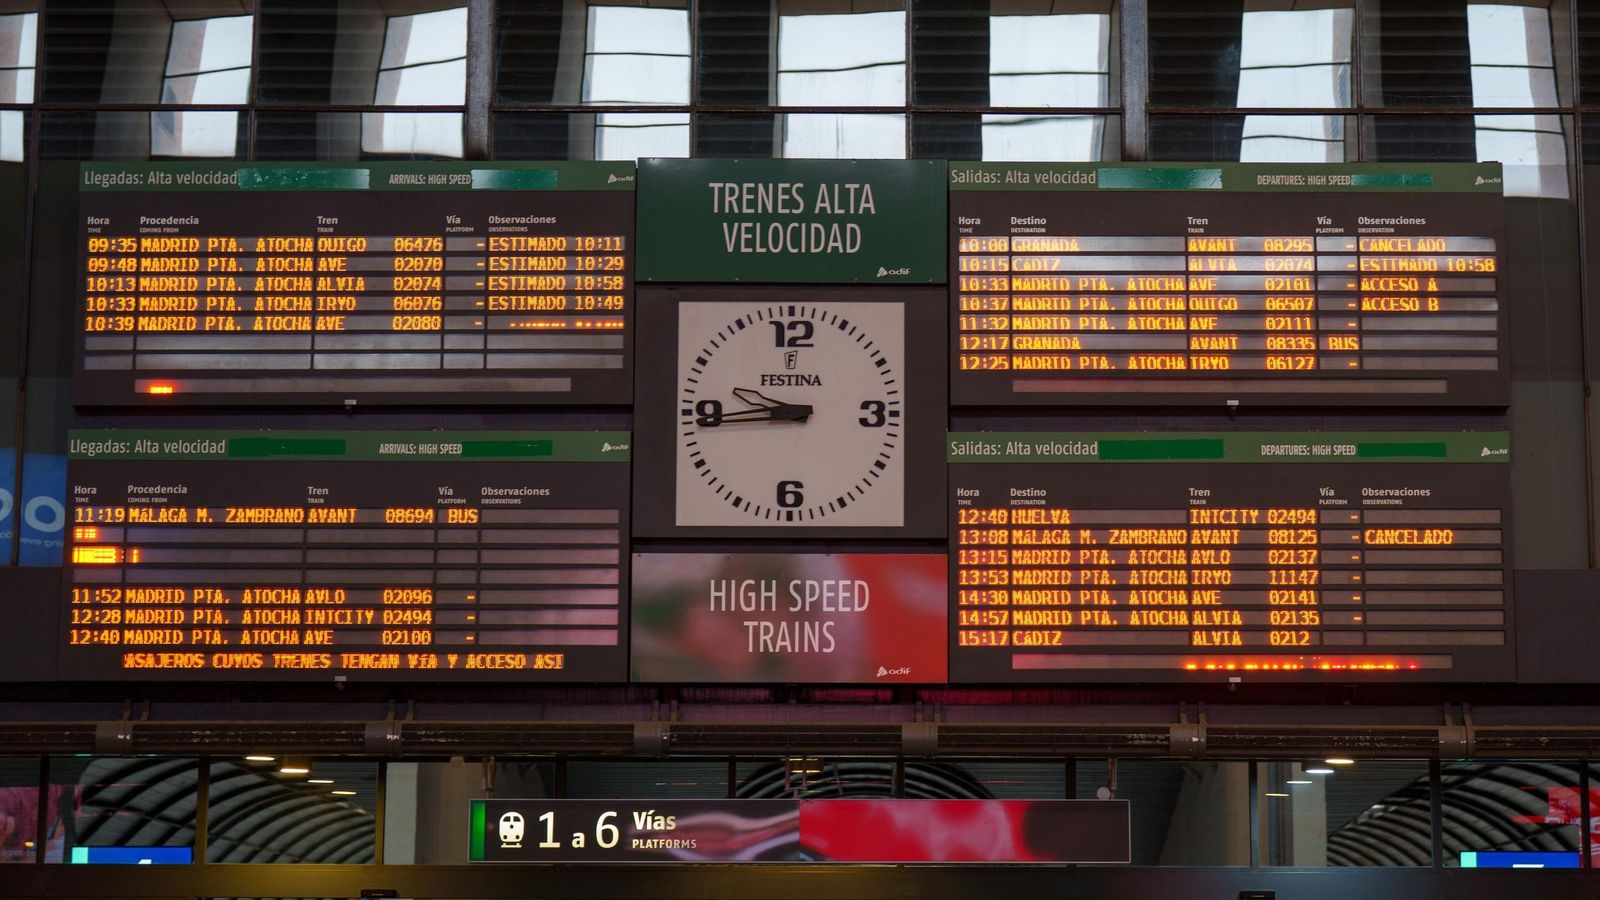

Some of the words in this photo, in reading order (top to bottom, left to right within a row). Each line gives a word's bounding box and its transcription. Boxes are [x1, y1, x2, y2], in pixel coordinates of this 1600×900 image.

[84, 171, 144, 188] Llegadas:
[147, 171, 172, 185] Alta
[176, 171, 237, 185] velocidad
[389, 174, 427, 185] ARRIVALS:
[428, 174, 447, 185] HIGH
[448, 174, 471, 185] SPEED
[951, 169, 1001, 184] Salidas:
[1005, 169, 1030, 184] Alta
[1034, 170, 1096, 184] velocidad
[1257, 175, 1306, 185] DEPARTURES:
[1307, 175, 1326, 185] HIGH
[1328, 175, 1351, 185] SPEED
[709, 182, 805, 214] TRENES
[814, 183, 876, 214] ALTA
[87, 216, 110, 225] Hora
[140, 216, 199, 225] Procedencia
[317, 216, 338, 225] Tren
[446, 215, 461, 224] Vía
[488, 215, 556, 224] Observaciones
[958, 216, 981, 225] Hora
[1010, 216, 1047, 225] Destino
[1187, 216, 1209, 225] Tren
[1317, 216, 1332, 225] Vía
[1357, 216, 1426, 225] Observaciones
[88, 237, 137, 252] 09:35
[141, 237, 200, 252] MADRID
[207, 237, 243, 252] PTA.
[255, 237, 314, 252] ATOCHA
[317, 237, 367, 252] OUIGO
[394, 237, 443, 252] 06476
[489, 237, 567, 252] ESTIMADO
[575, 237, 622, 252] 10:11
[722, 222, 862, 253] VELOCIDAD
[87, 257, 137, 272] 09:48
[140, 257, 199, 272] MADRID
[207, 257, 243, 272] PTA.
[255, 257, 313, 272] ATOCHA
[317, 257, 347, 272] AVE
[394, 257, 443, 271] 02070
[489, 257, 567, 271] ESTIMADO
[575, 257, 624, 271] 10:29
[889, 267, 911, 276] adif
[86, 277, 136, 292] 10:13
[139, 277, 198, 292] MADRID
[206, 277, 242, 292] PTA.
[254, 277, 313, 292] ATOCHA
[317, 277, 365, 292] ALVIA
[393, 277, 442, 291] 02074
[489, 277, 567, 291] ESTIMADO
[575, 277, 624, 291] 10:58
[1127, 297, 1185, 311] ATOCHA
[1265, 298, 1314, 312] 06507
[769, 320, 815, 348] 12
[960, 336, 1009, 350] 12:17
[1013, 336, 1081, 350] GRANADA
[1190, 336, 1238, 350] AVANT
[1266, 337, 1315, 351] 08335
[1328, 337, 1359, 351] BUS
[760, 374, 822, 387] FESTINA
[696, 400, 723, 427] 9
[858, 400, 886, 427] 3
[70, 439, 130, 456] Llegadas:
[134, 439, 159, 454] Alta
[163, 439, 226, 454] velocidad
[379, 443, 417, 454] ARRIVALS:
[418, 444, 438, 454] HIGH
[440, 444, 463, 454] SPEED
[951, 441, 1001, 456] Salidas:
[1005, 441, 1031, 456] Alta
[1035, 441, 1098, 456] velocidad
[1261, 445, 1310, 456] DEPARTURES:
[1312, 445, 1331, 456] HIGH
[1333, 445, 1356, 456] SPEED
[74, 485, 97, 495] Hora
[127, 485, 188, 495] Procedencia
[307, 486, 329, 495] Tren
[438, 486, 453, 495] Vía
[481, 487, 550, 496] Observaciones
[776, 480, 804, 508] 6
[957, 488, 980, 497] Hora
[1010, 488, 1047, 497] Destino
[1189, 487, 1210, 497] Tren
[1319, 487, 1335, 496] Vía
[1361, 487, 1431, 497] Observaciones
[75, 508, 125, 523] 11:19
[196, 508, 213, 523] M.
[225, 508, 305, 523] ZAMBRANO
[307, 508, 356, 523] AVANT
[385, 509, 434, 523] 08694
[447, 509, 479, 523] BUS
[958, 509, 1008, 524] 12:40
[1011, 509, 1070, 524] HUELVA
[1190, 509, 1259, 524] INTCITY
[1267, 509, 1317, 524] 02494
[958, 529, 1008, 545] 13:08
[1079, 529, 1097, 545] M.
[1108, 529, 1187, 545] ZAMBRANO
[1191, 529, 1240, 545] AVANT
[1268, 529, 1317, 545] 08125
[1364, 529, 1453, 545] CANCELADO
[958, 570, 1008, 585] 13:53
[1011, 570, 1071, 585] MADRID
[1080, 570, 1117, 585] PTA.
[1129, 570, 1188, 585] ATOCHA
[1191, 570, 1232, 585] IRYO
[1269, 570, 1319, 585] 11147
[71, 589, 122, 604] 11:52
[125, 589, 185, 604] MADRID
[193, 589, 230, 604] PTA.
[242, 589, 300, 604] ATOCHA
[305, 589, 345, 604] AVLO
[383, 589, 433, 604] 02096
[709, 580, 777, 612] HIGH
[789, 580, 870, 612] SPEED
[71, 609, 121, 624] 12:28
[125, 609, 184, 624] MADRID
[192, 609, 230, 624] PTA.
[241, 609, 300, 624] ATOCHA
[304, 609, 374, 624] INTCITY
[383, 610, 432, 625] 02494
[958, 610, 1008, 625] 14:57
[1012, 610, 1072, 625] MADRID
[1081, 610, 1118, 625] PTA.
[1130, 610, 1189, 625] ATOCHA
[1192, 610, 1243, 625] ALVIA
[1270, 610, 1320, 625] 02135
[744, 621, 835, 653] TRAINS
[889, 667, 911, 675] adif
[538, 811, 561, 848] 1
[571, 832, 585, 849] a
[595, 811, 619, 849] 6
[632, 809, 676, 831] Vías
[632, 839, 697, 849] PLATFORMS
